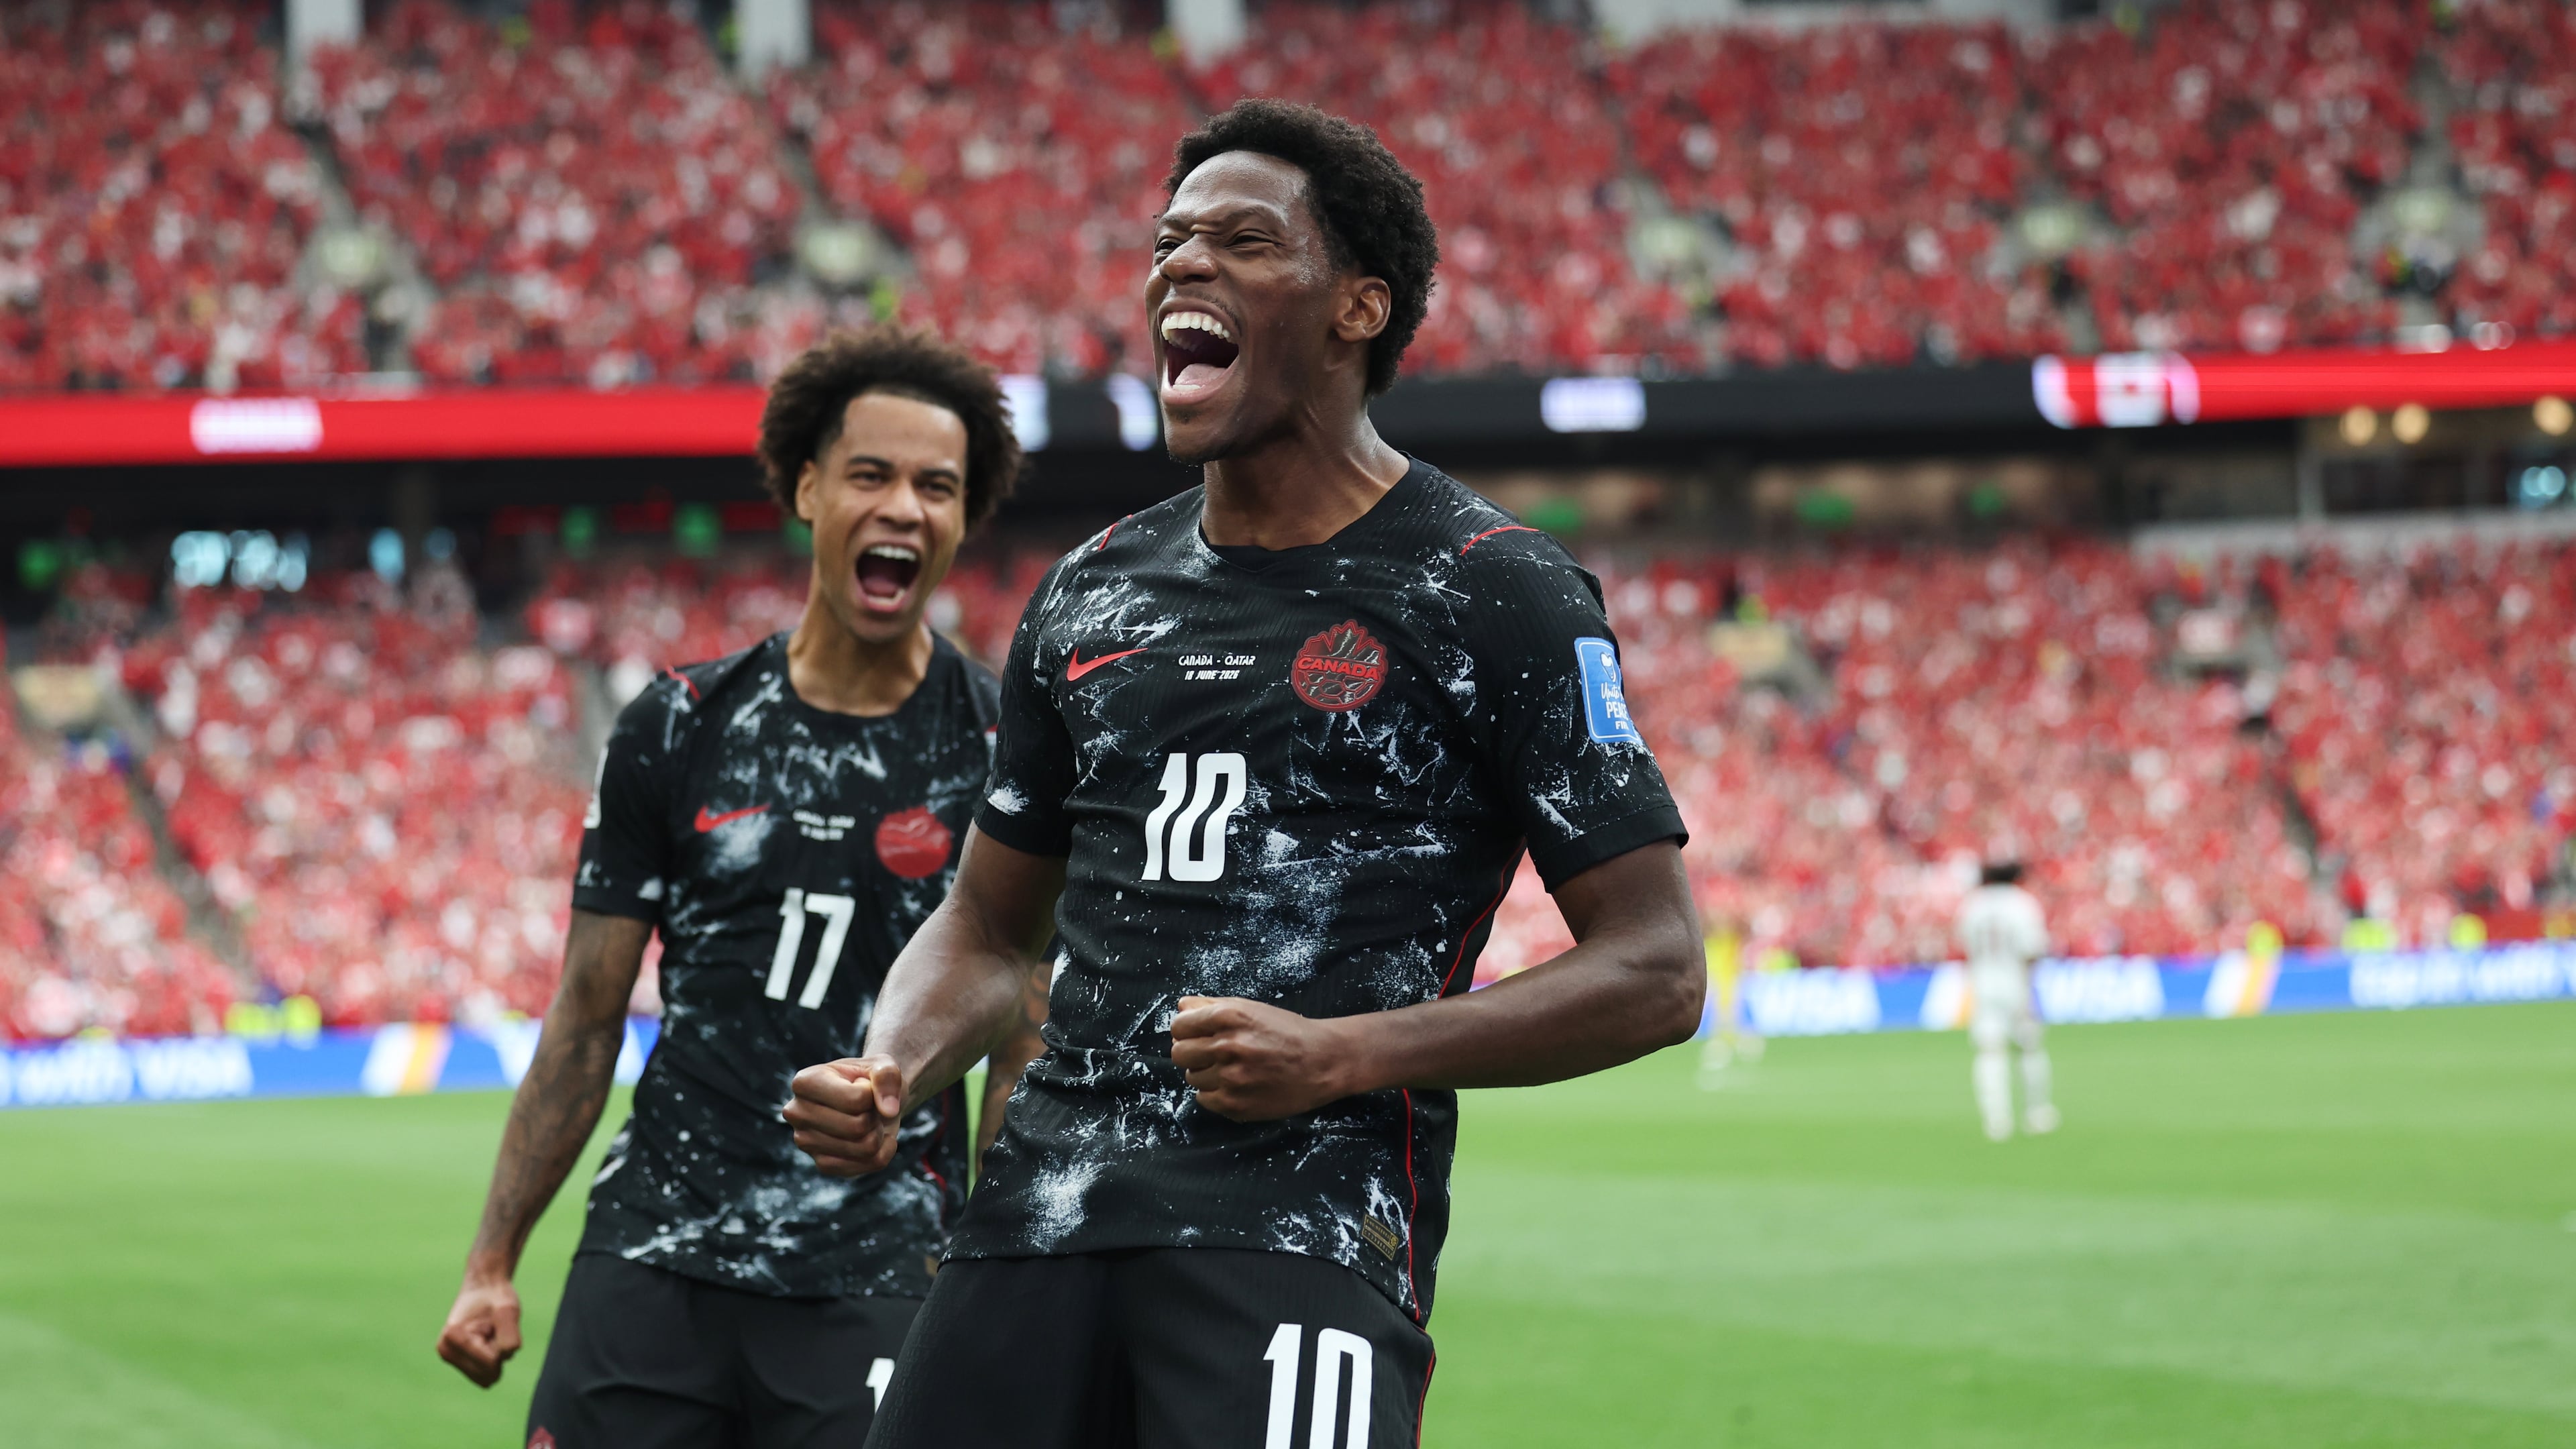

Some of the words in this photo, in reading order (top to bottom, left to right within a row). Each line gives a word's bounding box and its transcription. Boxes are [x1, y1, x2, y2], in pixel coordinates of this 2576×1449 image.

[1178, 655, 1213, 666] CANADA
[1224, 655, 1256, 665] QATAR
[1184, 670, 1195, 680] 18
[1195, 670, 1218, 680] JUNE
[1218, 670, 1240, 680] 2026
[1297, 657, 1379, 680] CANADA
[1141, 753, 1246, 881] 10
[765, 887, 855, 1010] 17
[1263, 1323, 1373, 1449] 10
